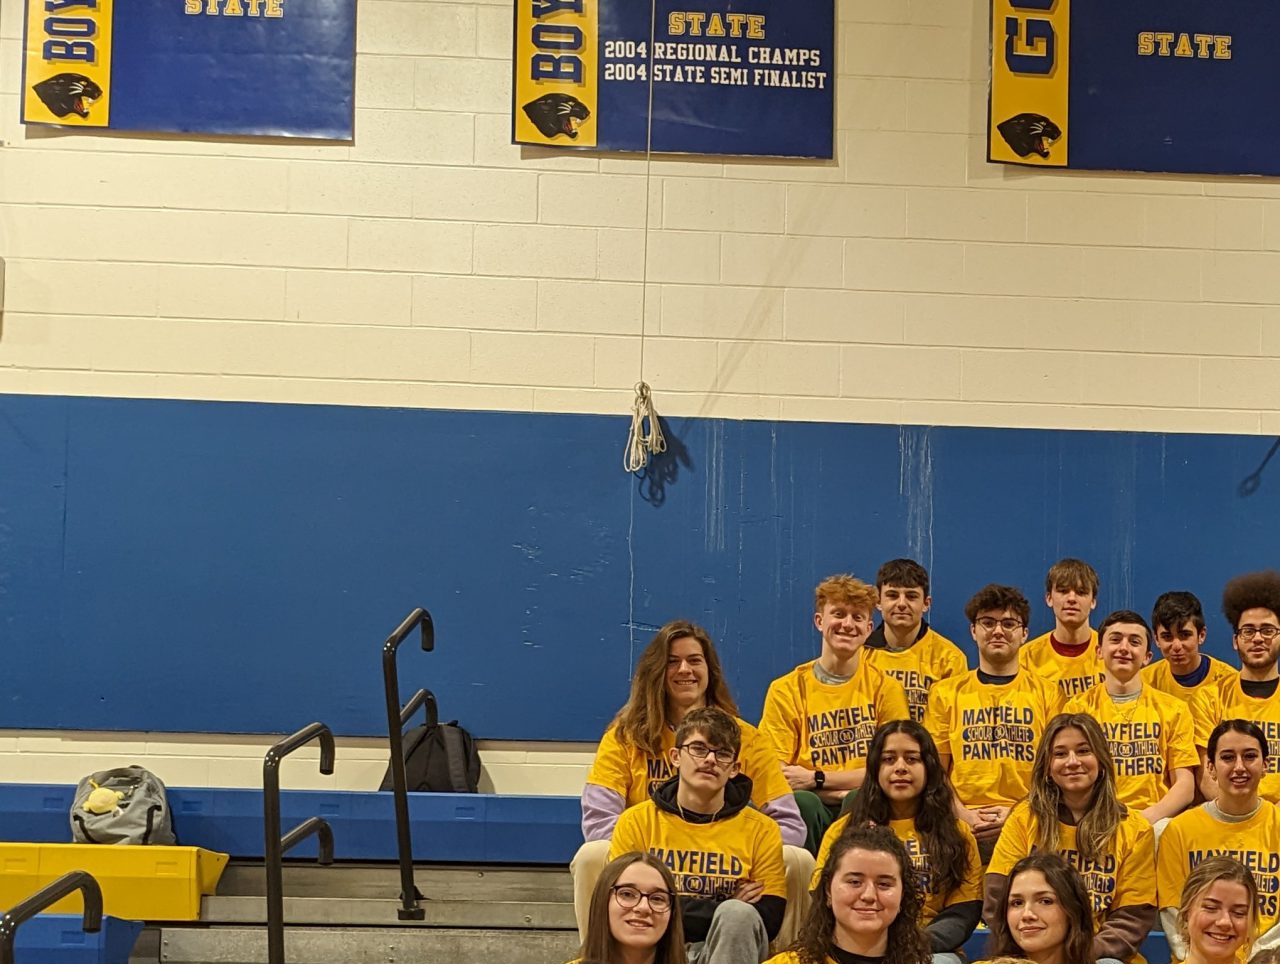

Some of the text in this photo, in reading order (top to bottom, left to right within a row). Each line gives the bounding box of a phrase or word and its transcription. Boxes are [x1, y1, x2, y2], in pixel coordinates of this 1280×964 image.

[185, 0, 284, 17] STATE
[668, 12, 765, 39] STATE
[604, 41, 820, 66] 2004 REGIONAL CHAMPS
[1137, 32, 1232, 60] STATE
[604, 64, 827, 89] 2004 STATE SEMI FINALIST
[962, 706, 1034, 726] MAYFIELD
[967, 726, 993, 741] SCHOLAR
[1102, 721, 1161, 740] AYFIELD
[811, 739, 872, 767] PANTHE
[962, 743, 1035, 762] PANTHERS
[1117, 757, 1163, 776] THERS
